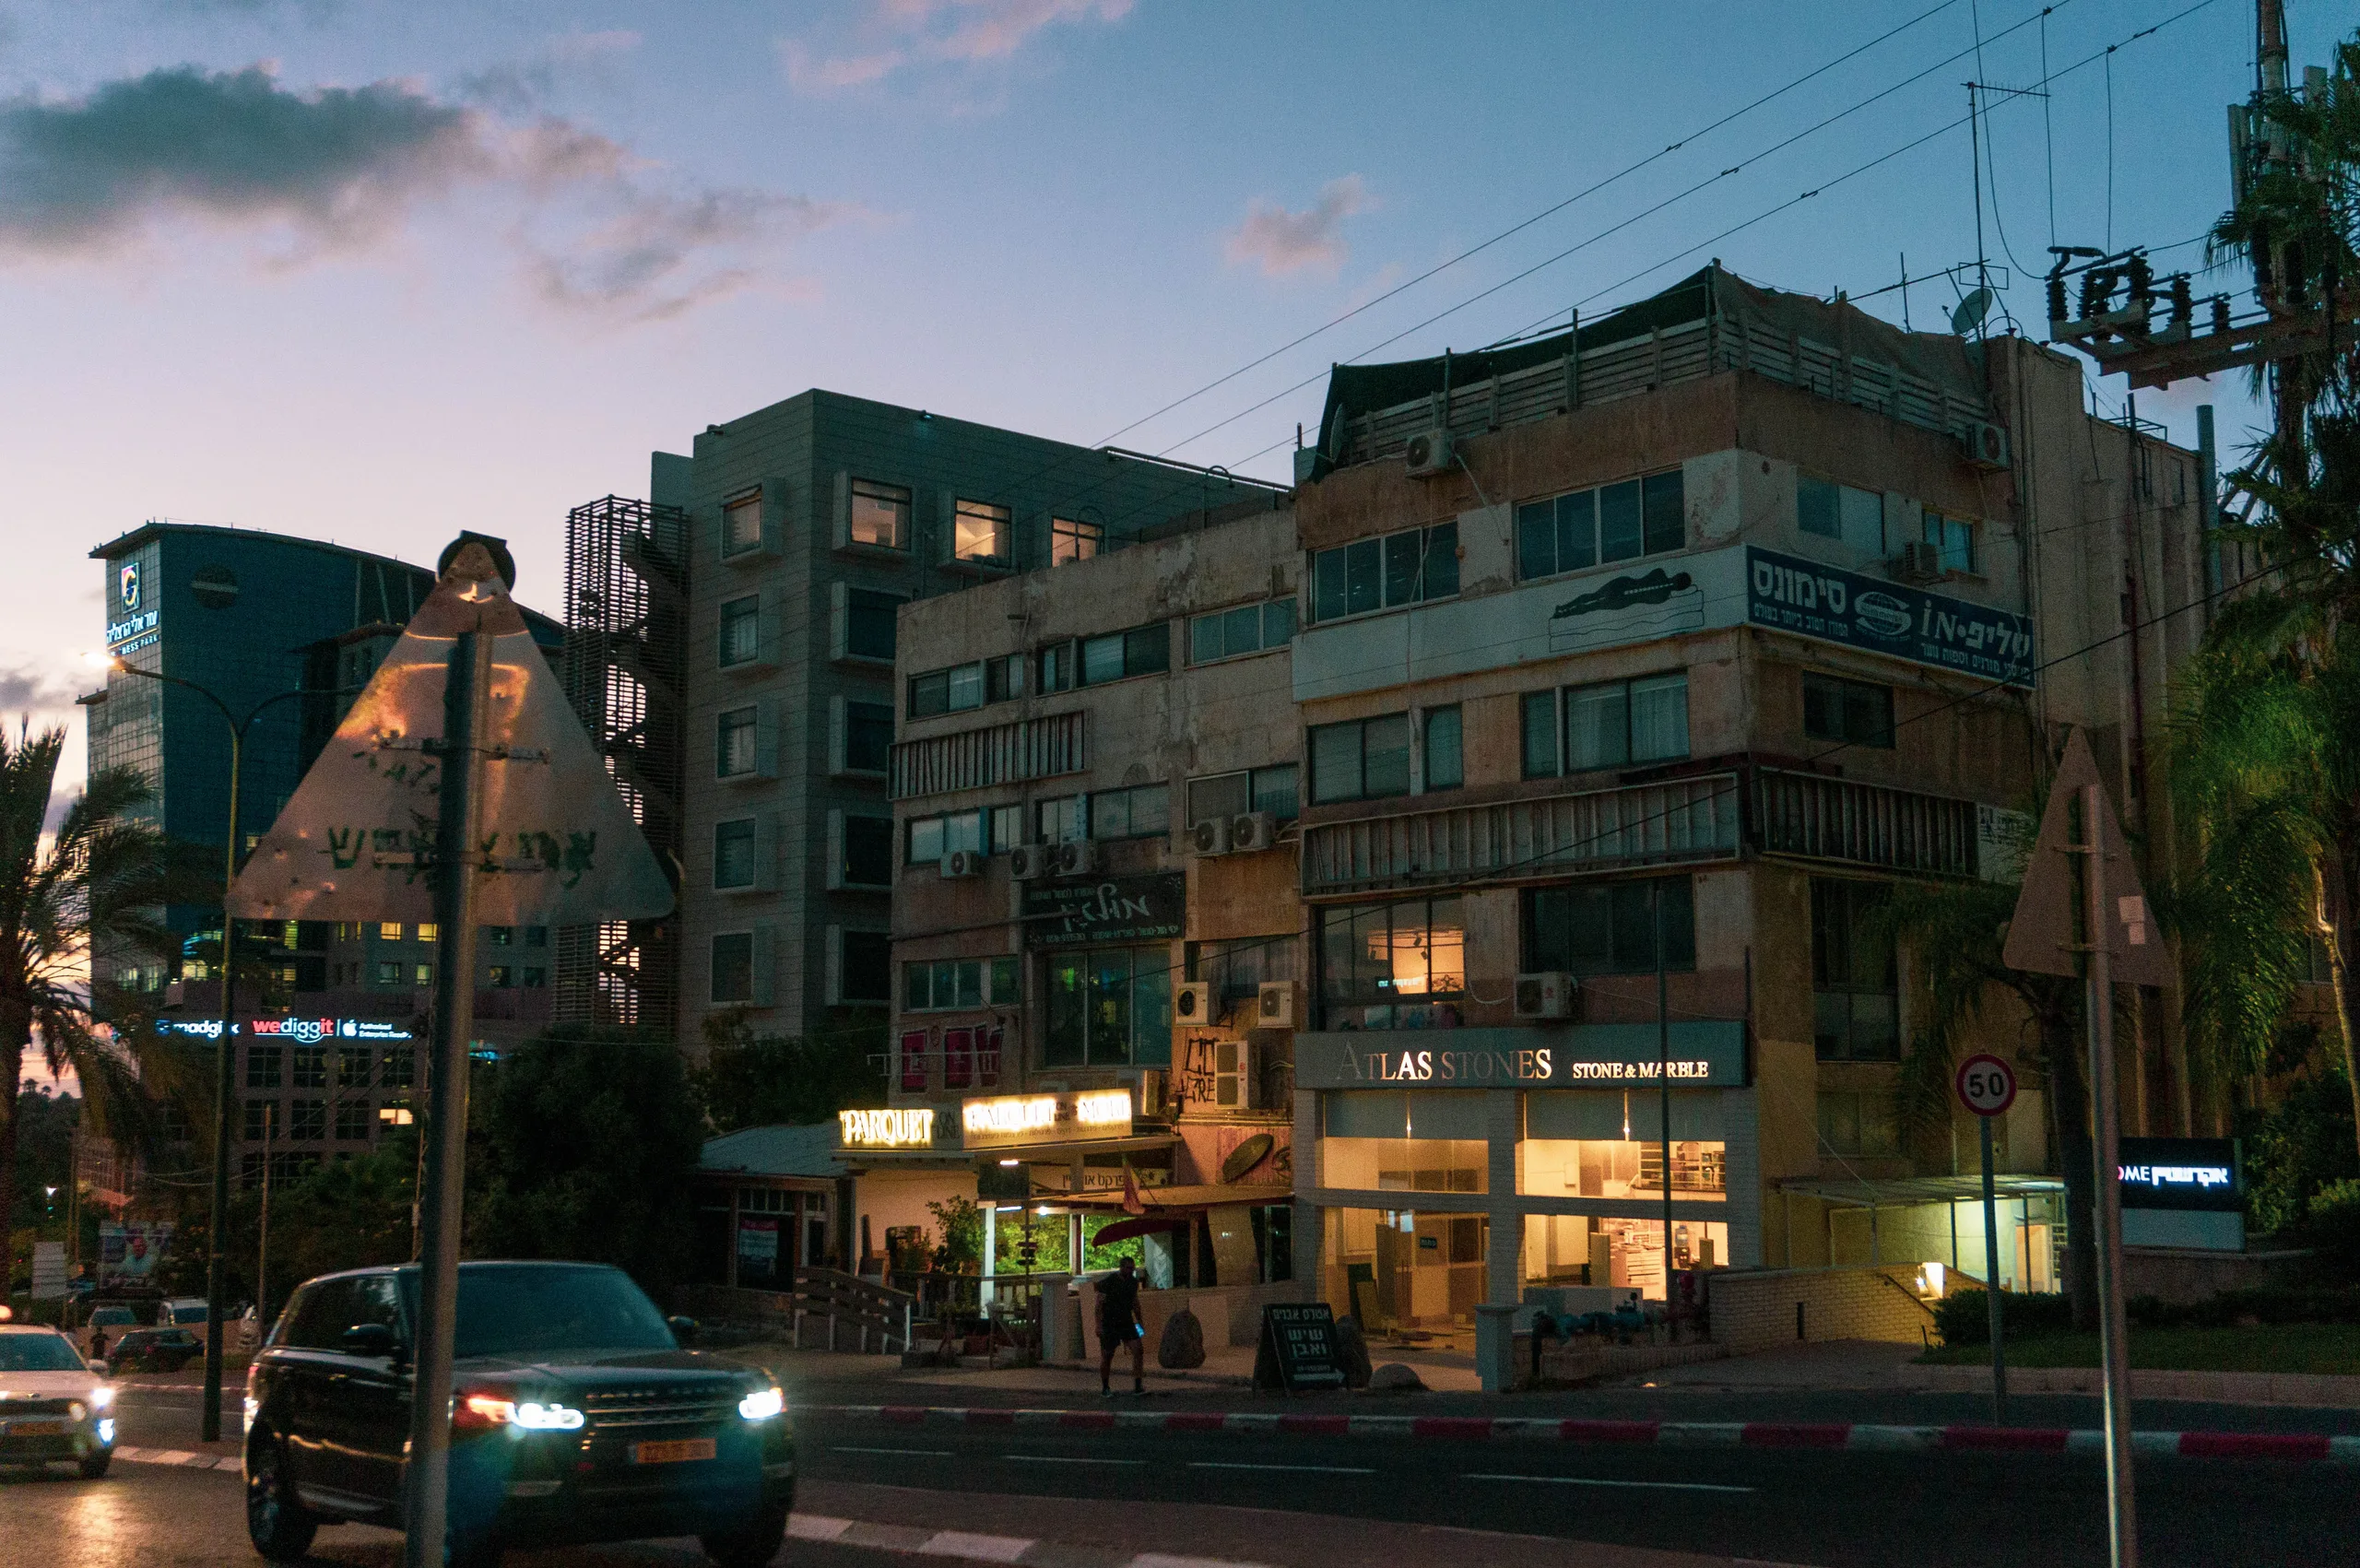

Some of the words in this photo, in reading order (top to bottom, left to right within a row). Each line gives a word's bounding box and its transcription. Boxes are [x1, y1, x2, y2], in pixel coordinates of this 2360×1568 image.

[1752, 560, 1847, 615] סימונס
[253, 1018, 334, 1040] wediggit
[1441, 1049, 1552, 1079] STONES
[1573, 1062, 1622, 1079] STONE
[1623, 1063, 1637, 1079] &
[1638, 1062, 1709, 1079] MARBLE
[1969, 1072, 2004, 1098] 50
[964, 1099, 1056, 1129] PARQUET
[1077, 1095, 1131, 1123] MORE
[840, 1109, 934, 1145] PARQUET
[1287, 1329, 1324, 1340] שיש
[1291, 1343, 1328, 1358] ואבן
